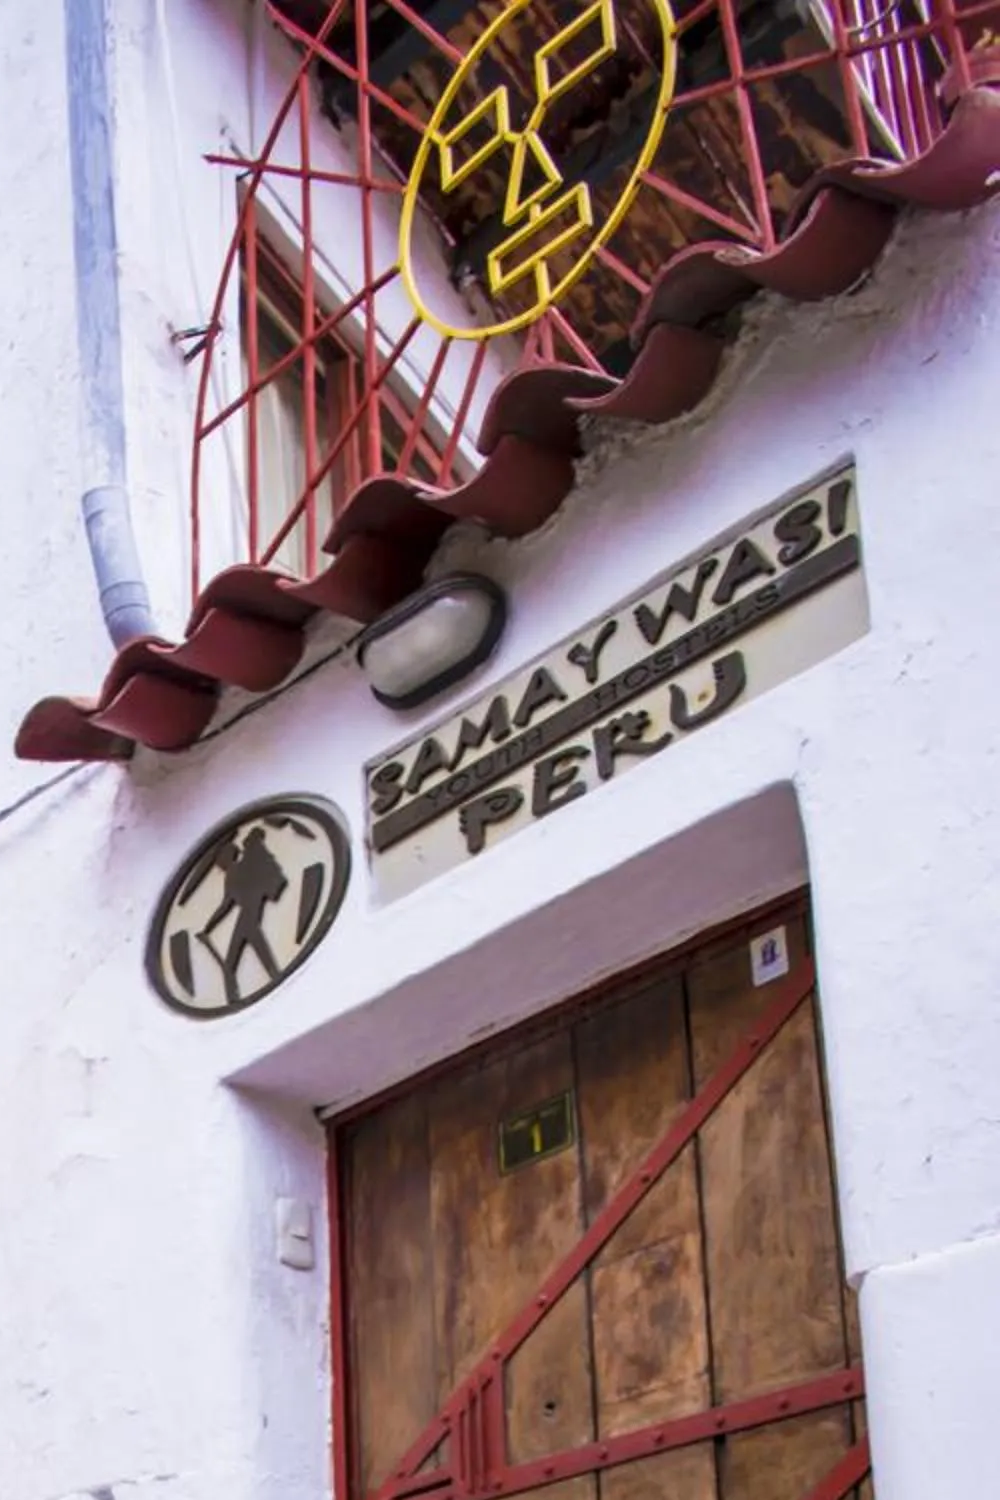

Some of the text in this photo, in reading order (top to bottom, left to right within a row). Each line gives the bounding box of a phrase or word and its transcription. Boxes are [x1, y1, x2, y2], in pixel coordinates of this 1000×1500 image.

[370, 477, 853, 816] SAMAY WASI
[424, 583, 780, 809] YOUTH HOSTELS
[458, 649, 748, 855] PERU
